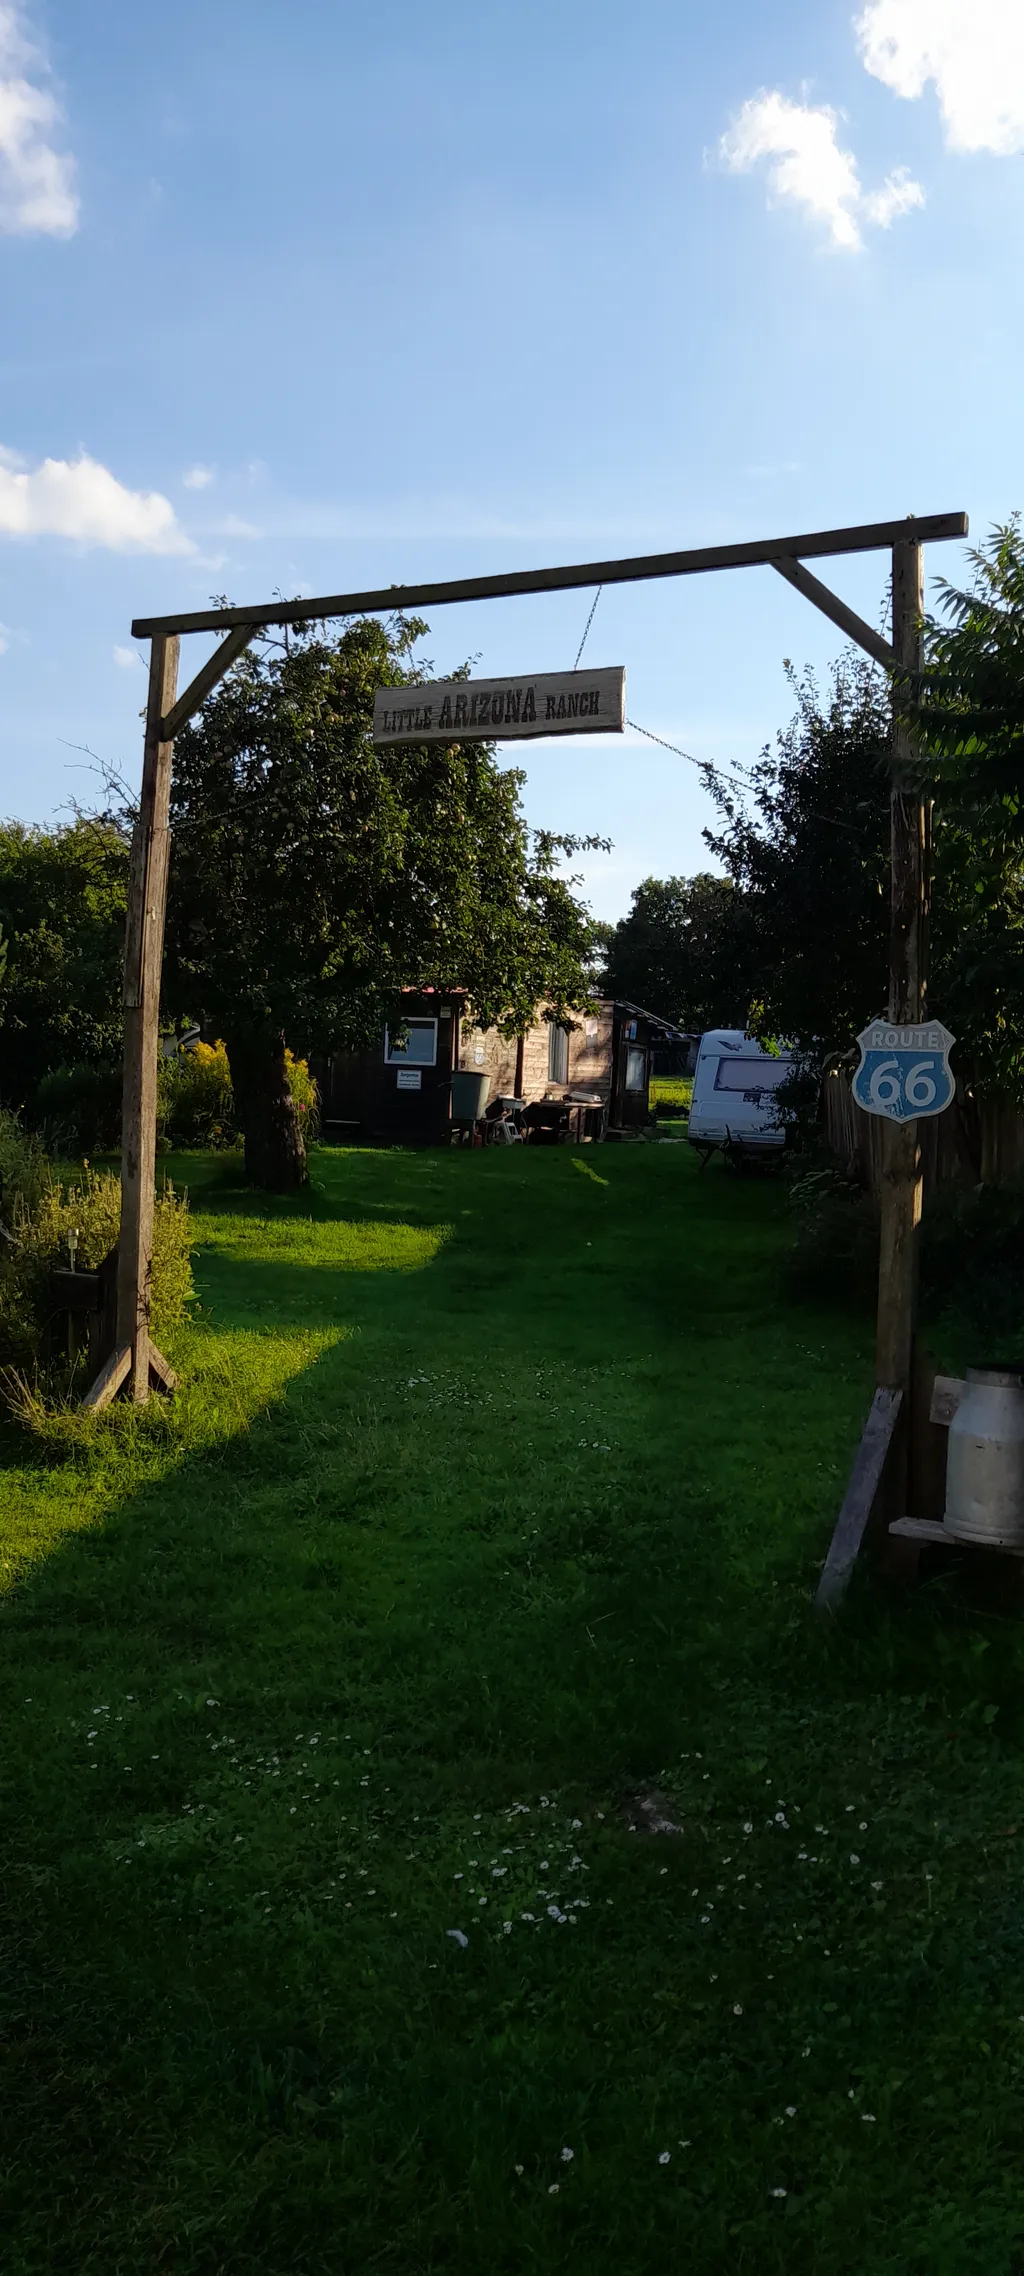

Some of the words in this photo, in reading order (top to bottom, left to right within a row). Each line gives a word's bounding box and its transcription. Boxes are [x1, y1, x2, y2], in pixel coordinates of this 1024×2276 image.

[382, 704, 433, 734] LITTLE
[438, 687, 537, 730] ARIZONA
[545, 691, 600, 720] RANCH
[871, 1031, 940, 1048] ROUTE
[870, 1060, 937, 1107] 66
